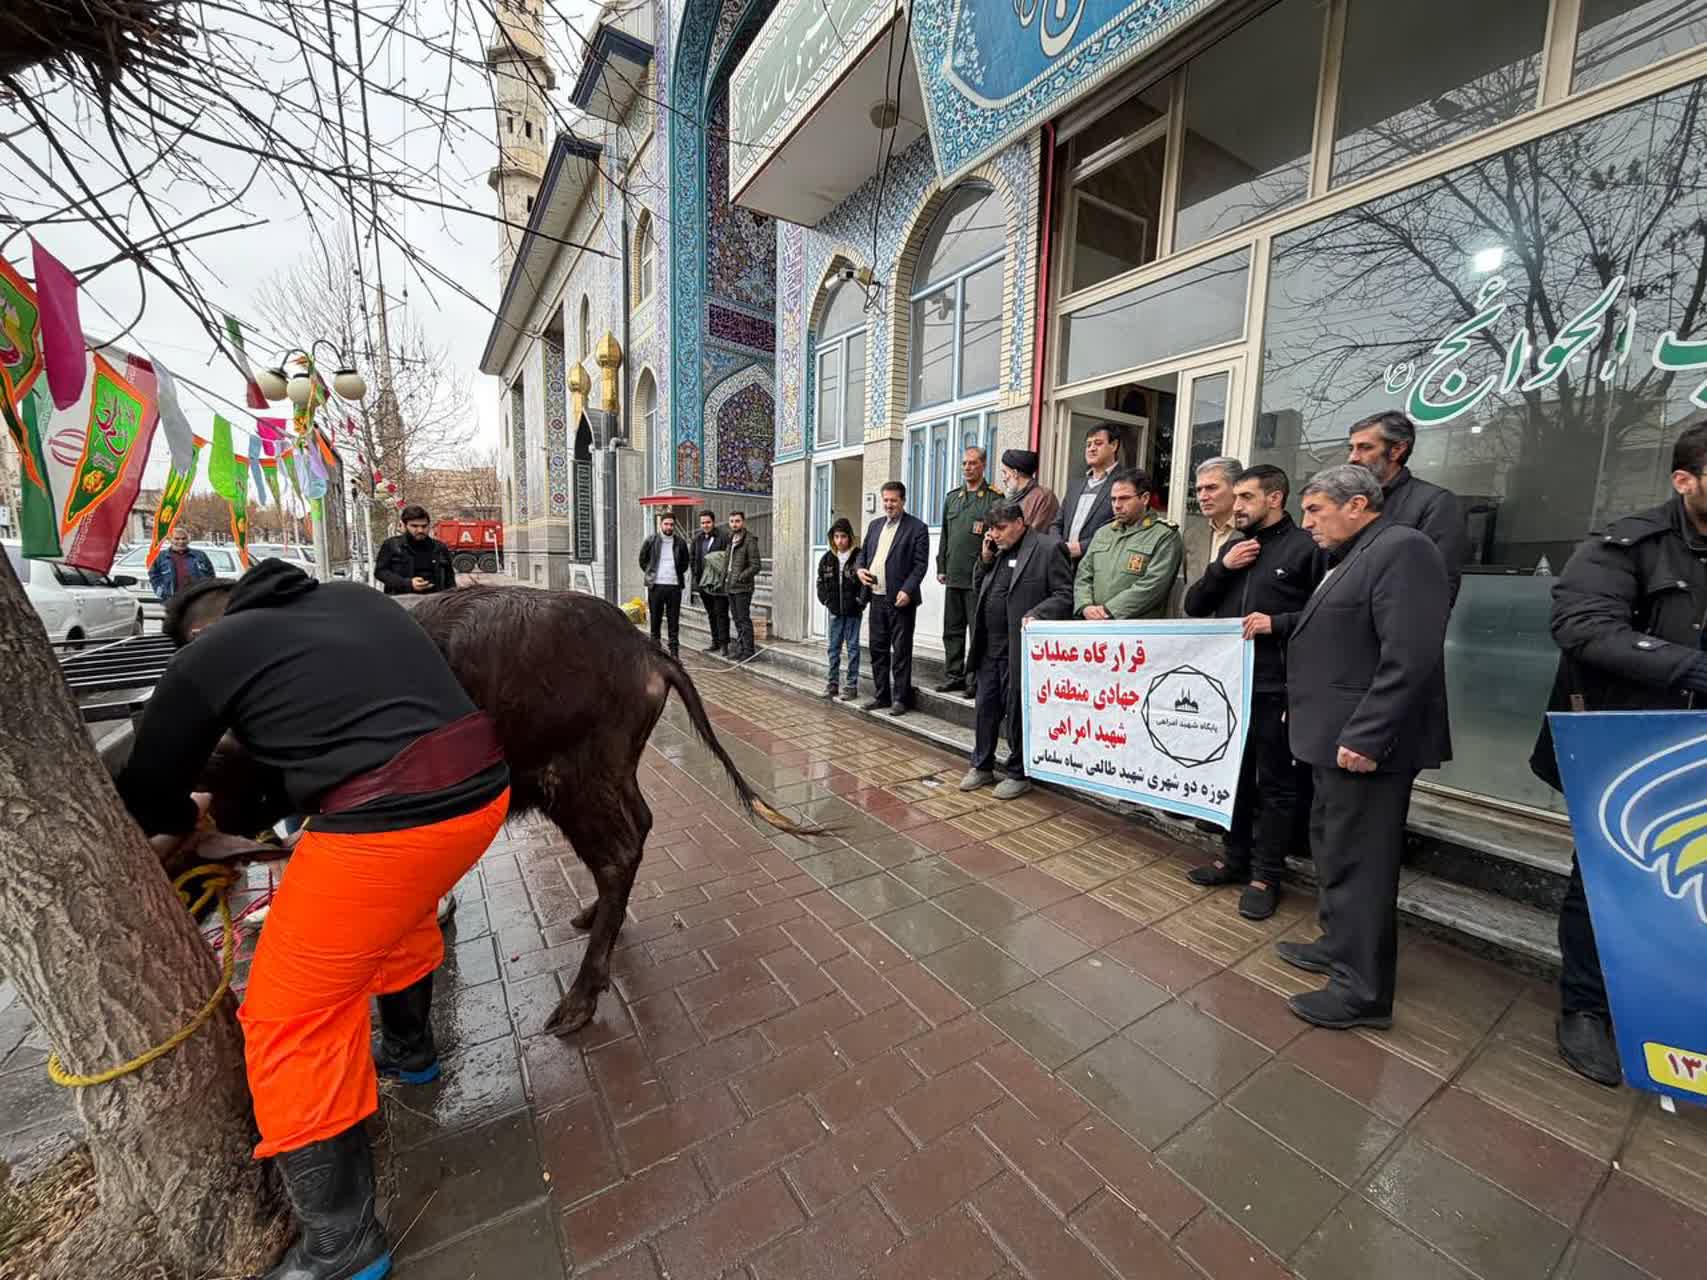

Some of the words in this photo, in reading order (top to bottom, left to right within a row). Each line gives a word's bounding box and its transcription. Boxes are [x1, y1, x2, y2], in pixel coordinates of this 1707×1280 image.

[1031, 639, 1079, 667] عملیات
[1036, 678, 1051, 704] ای
[1054, 678, 1090, 702] منطقه
[1093, 682, 1140, 713] جهادی
[1095, 722, 1127, 749] شهید
[1032, 749, 1063, 765] سلماس
[1064, 752, 1083, 774] سپاه
[1119, 767, 1144, 784] شهید
[1147, 773, 1180, 792] شهری
[1183, 781, 1198, 798] دو
[1201, 785, 1231, 805] حوزه
[1667, 1052, 1707, 1081] ۱۳
